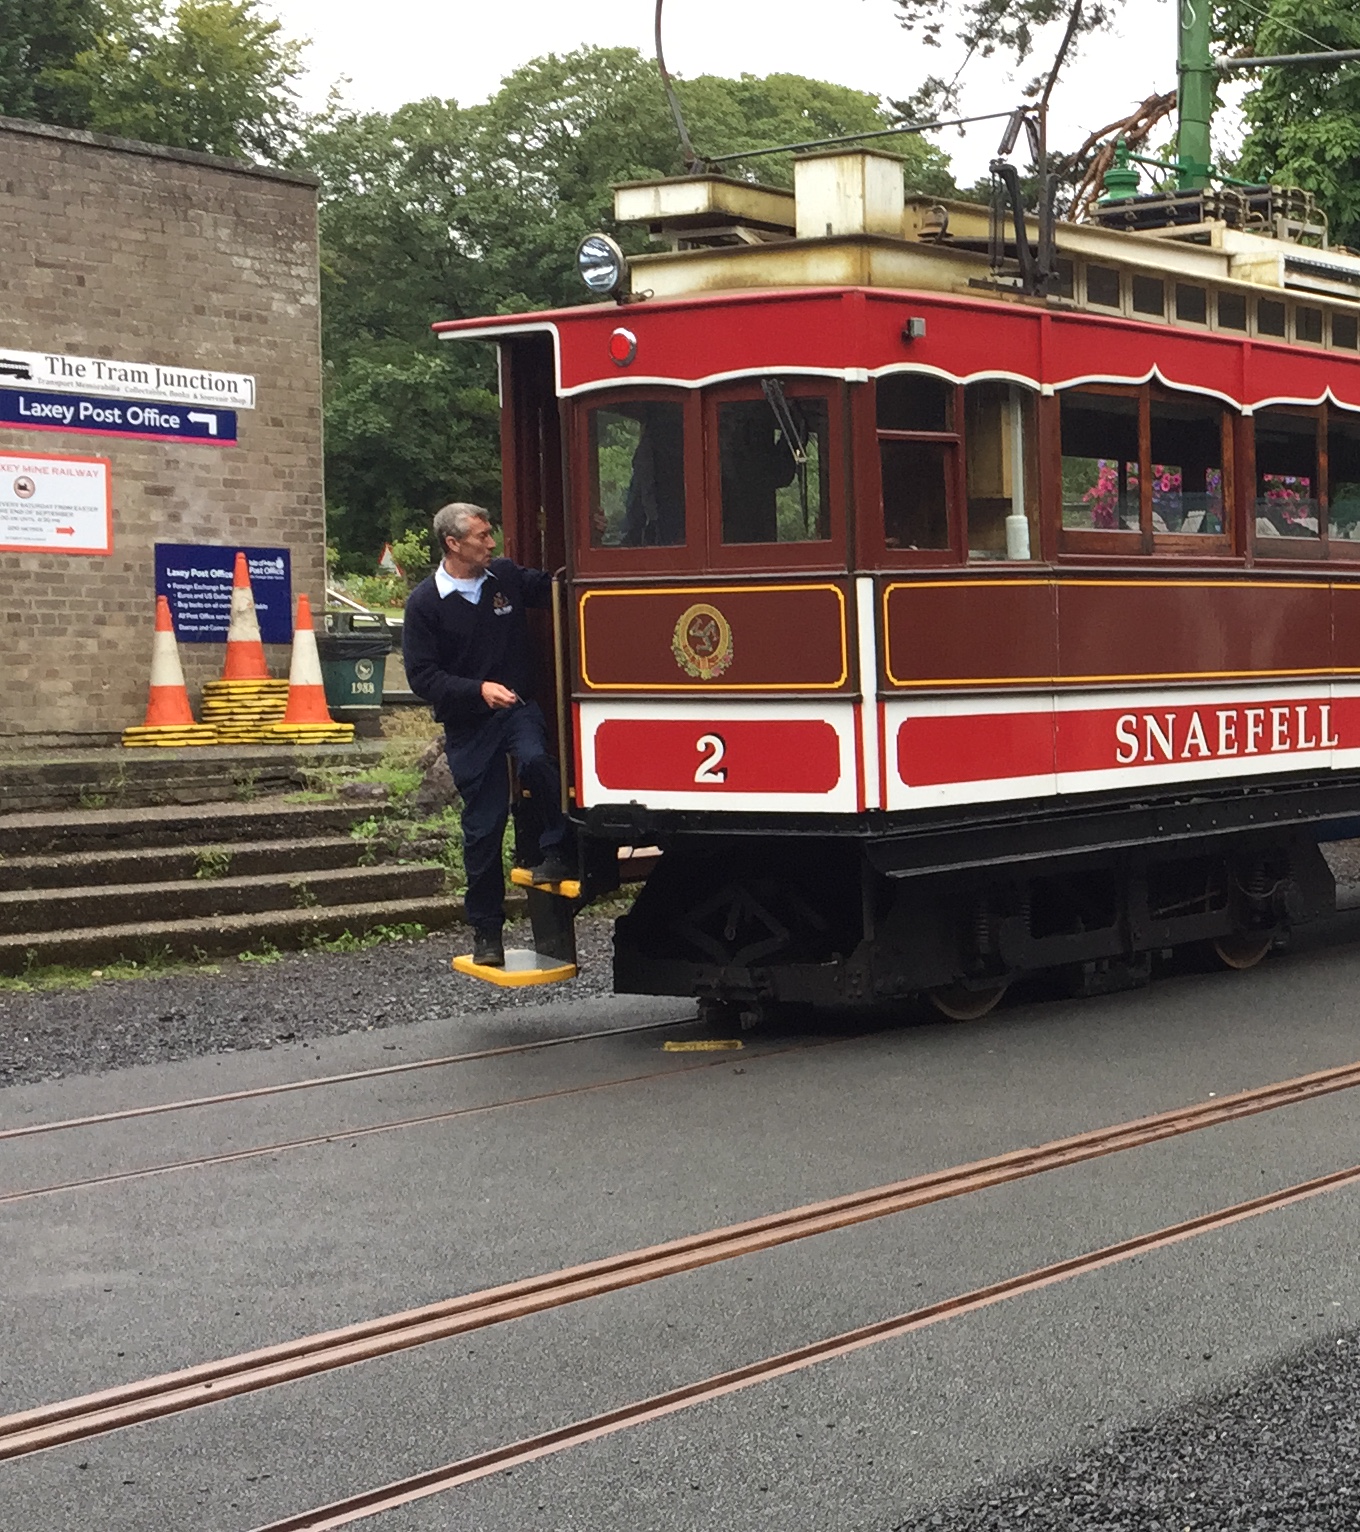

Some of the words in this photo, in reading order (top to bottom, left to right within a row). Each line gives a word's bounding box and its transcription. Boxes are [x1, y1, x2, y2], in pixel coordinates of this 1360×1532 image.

[45, 356, 86, 377] The
[92, 361, 149, 384] Tram
[155, 367, 239, 393] Junction
[19, 396, 75, 424] Laxey
[79, 402, 122, 424] Post
[126, 406, 181, 429] Office
[22, 465, 50, 474] MINE
[52, 467, 99, 478] RAILWAY
[166, 567, 190, 580] Laxey
[190, 568, 209, 578] Post
[210, 568, 234, 579] Office
[1115, 704, 1339, 764] SNAEFELL
[694, 732, 727, 784] 2
